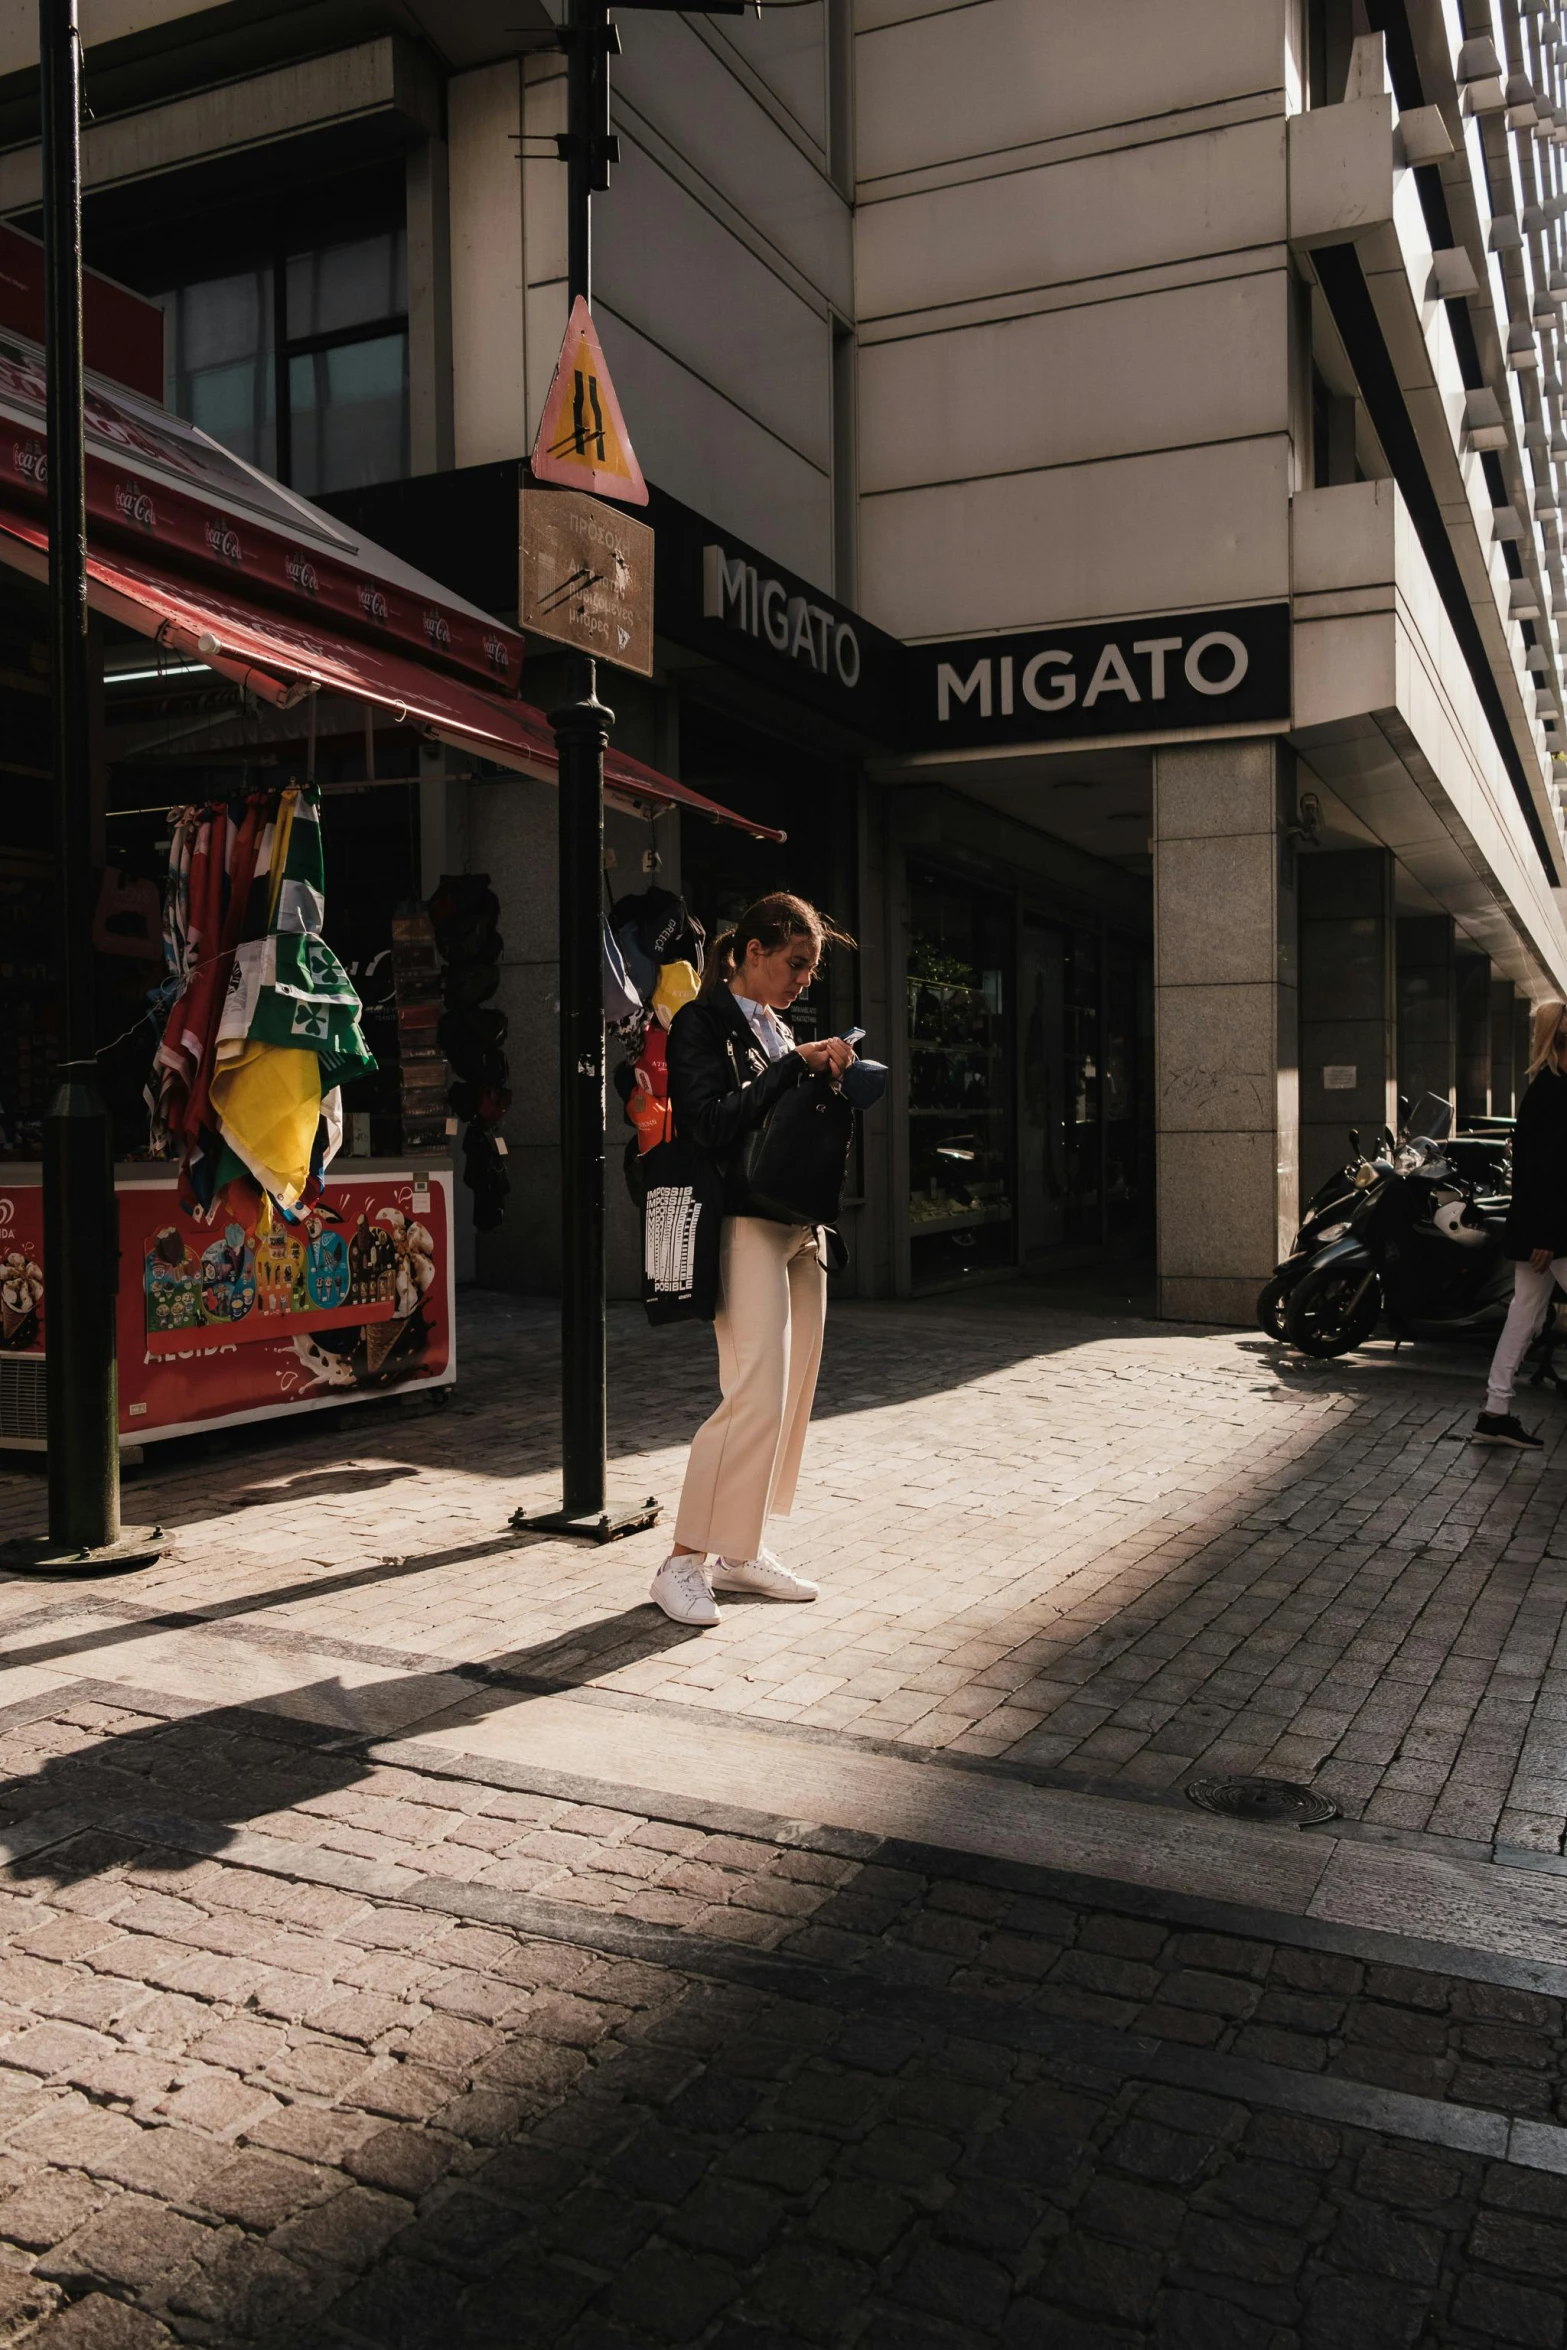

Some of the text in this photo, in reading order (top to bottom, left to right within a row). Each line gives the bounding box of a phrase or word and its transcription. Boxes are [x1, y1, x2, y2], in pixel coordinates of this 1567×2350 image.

[569, 513, 631, 558] ΠΡΟΣΟΧΗ
[703, 544, 861, 688] MIGATO
[937, 630, 1249, 722] MIGATO
[654, 918, 677, 953] GREECE
[654, 1280, 693, 1293] POSIBLE
